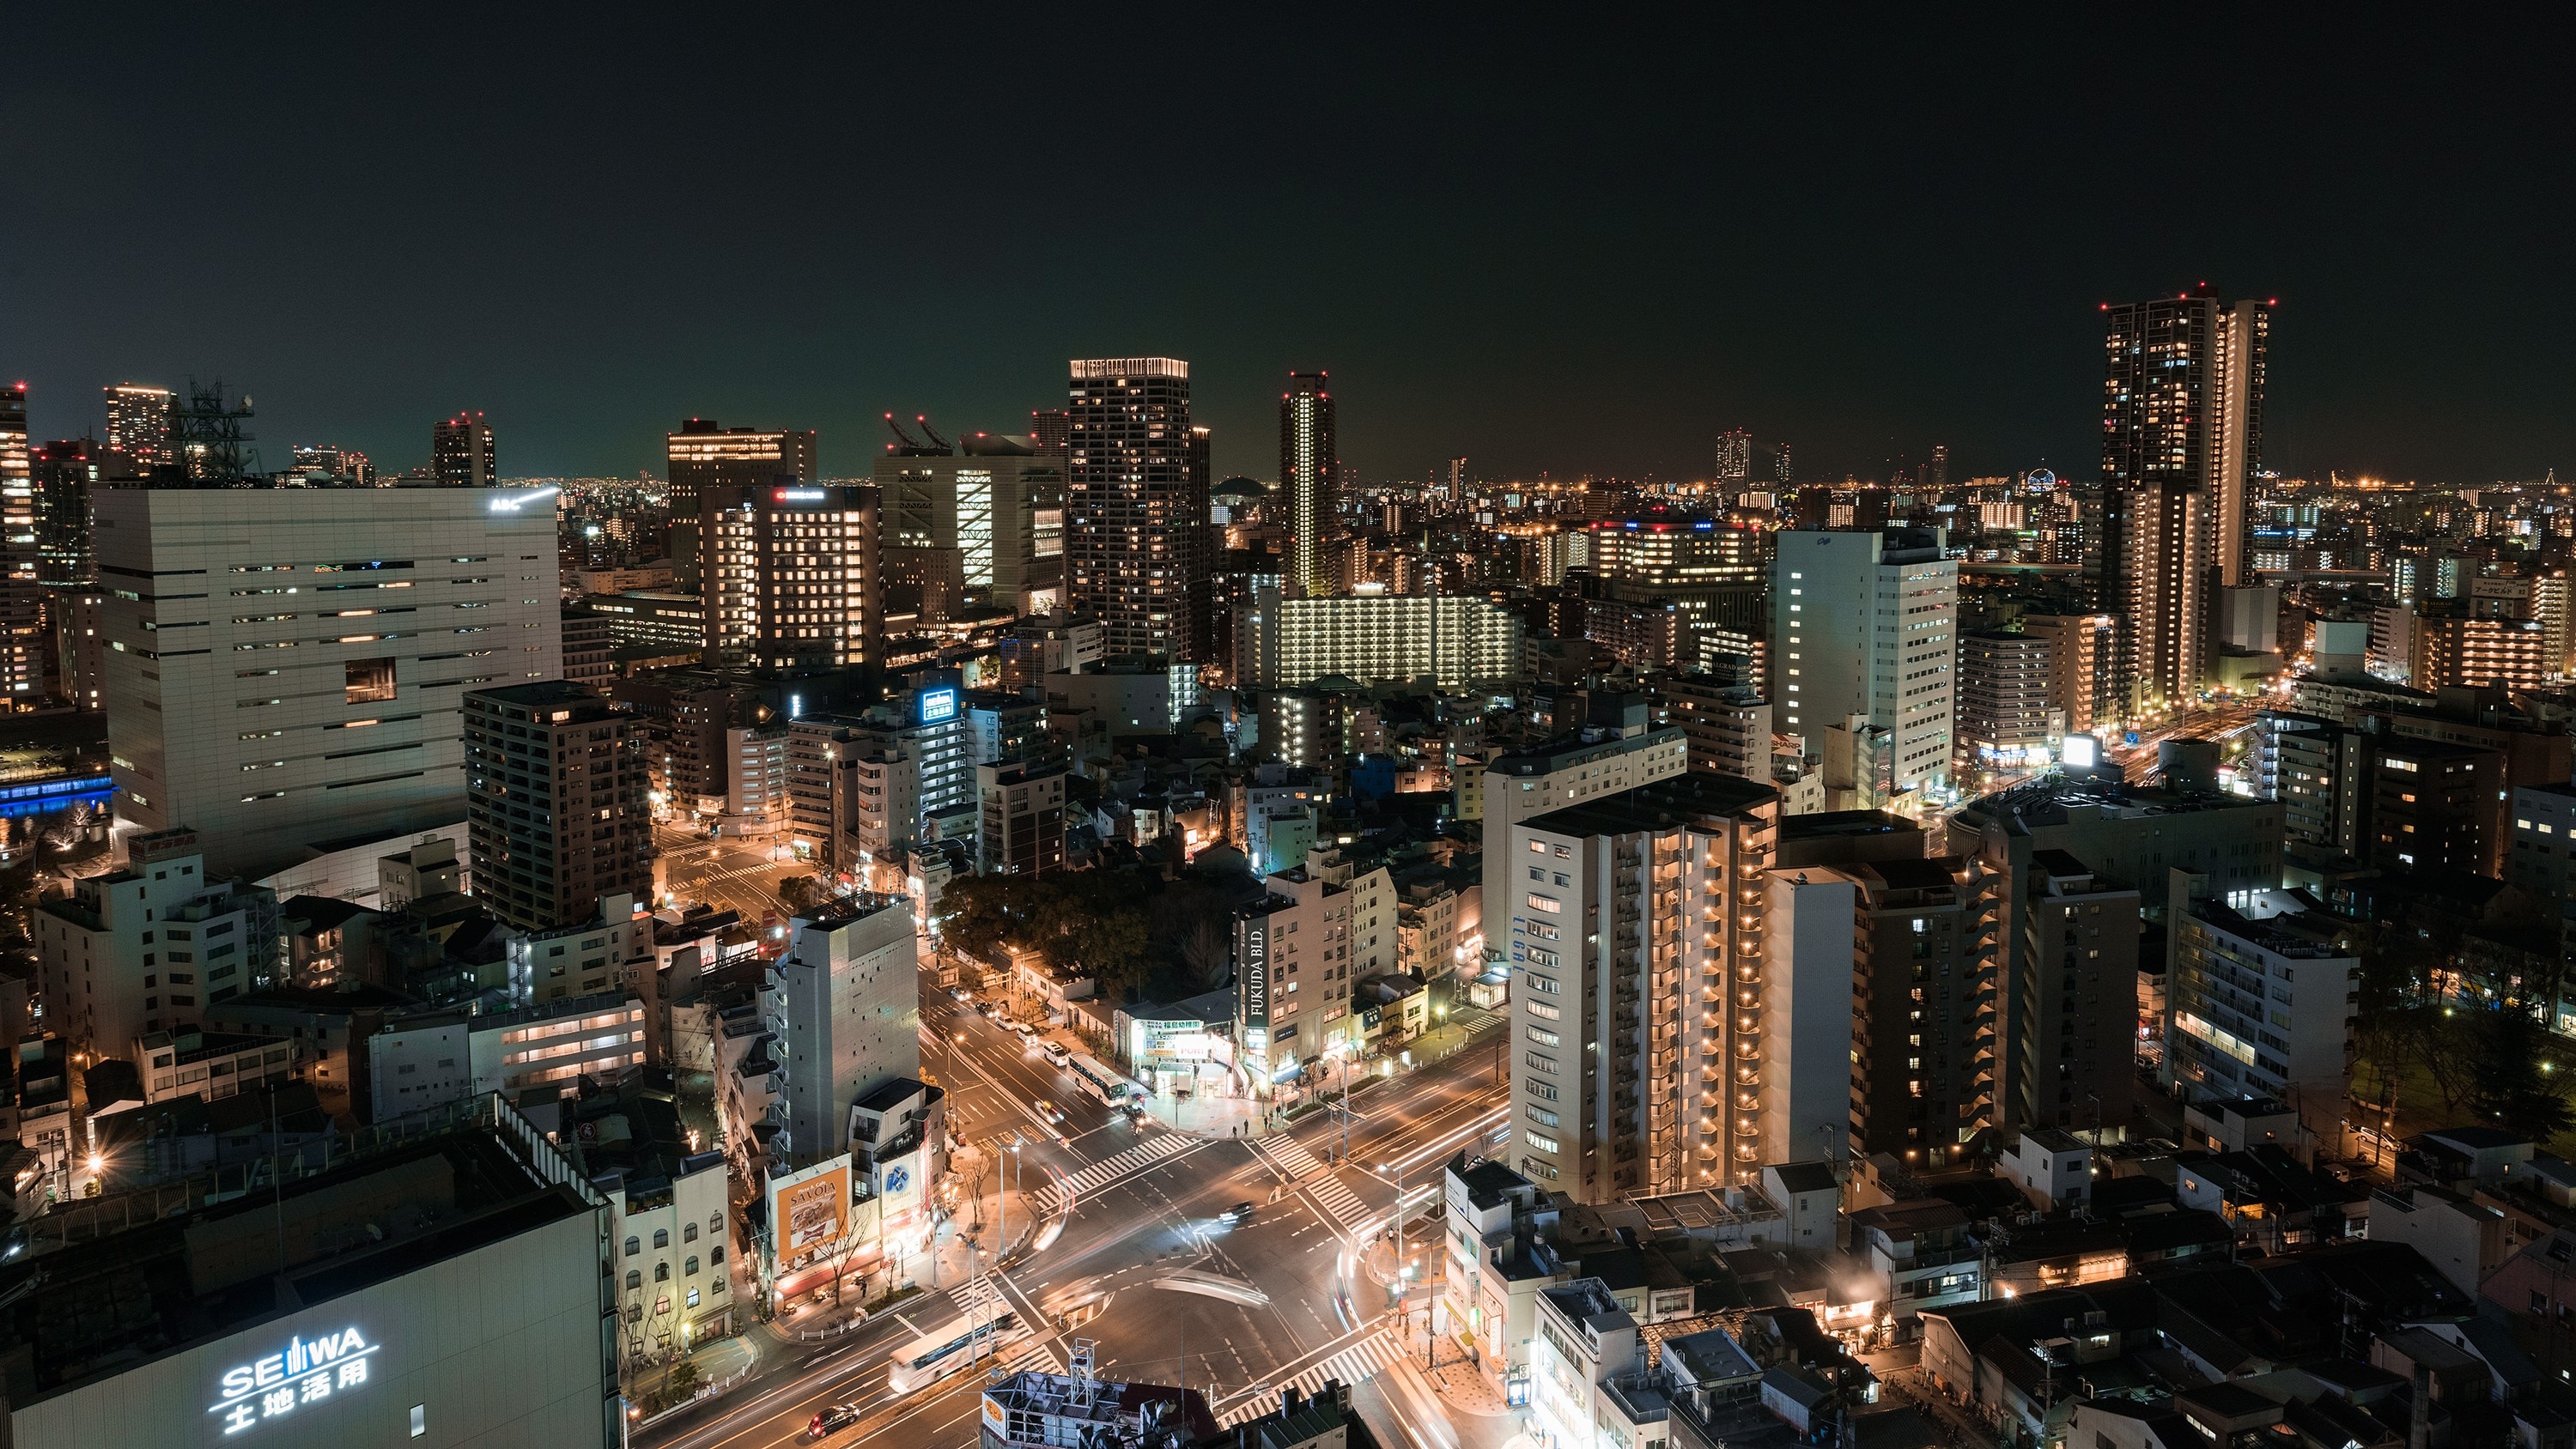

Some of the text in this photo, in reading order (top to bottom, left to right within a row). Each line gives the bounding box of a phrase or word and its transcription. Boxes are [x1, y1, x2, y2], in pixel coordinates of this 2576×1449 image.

[490, 499, 521, 511] ABC
[1771, 740, 1801, 749] SHARP
[1250, 927, 1264, 1016] FUKUDA BLD.
[1163, 1021, 1200, 1029] 福島幼稚園
[1020, 1125, 1047, 1143] 50
[790, 1182, 836, 1206] SAVOIA
[224, 1357, 368, 1435] 土地活用
